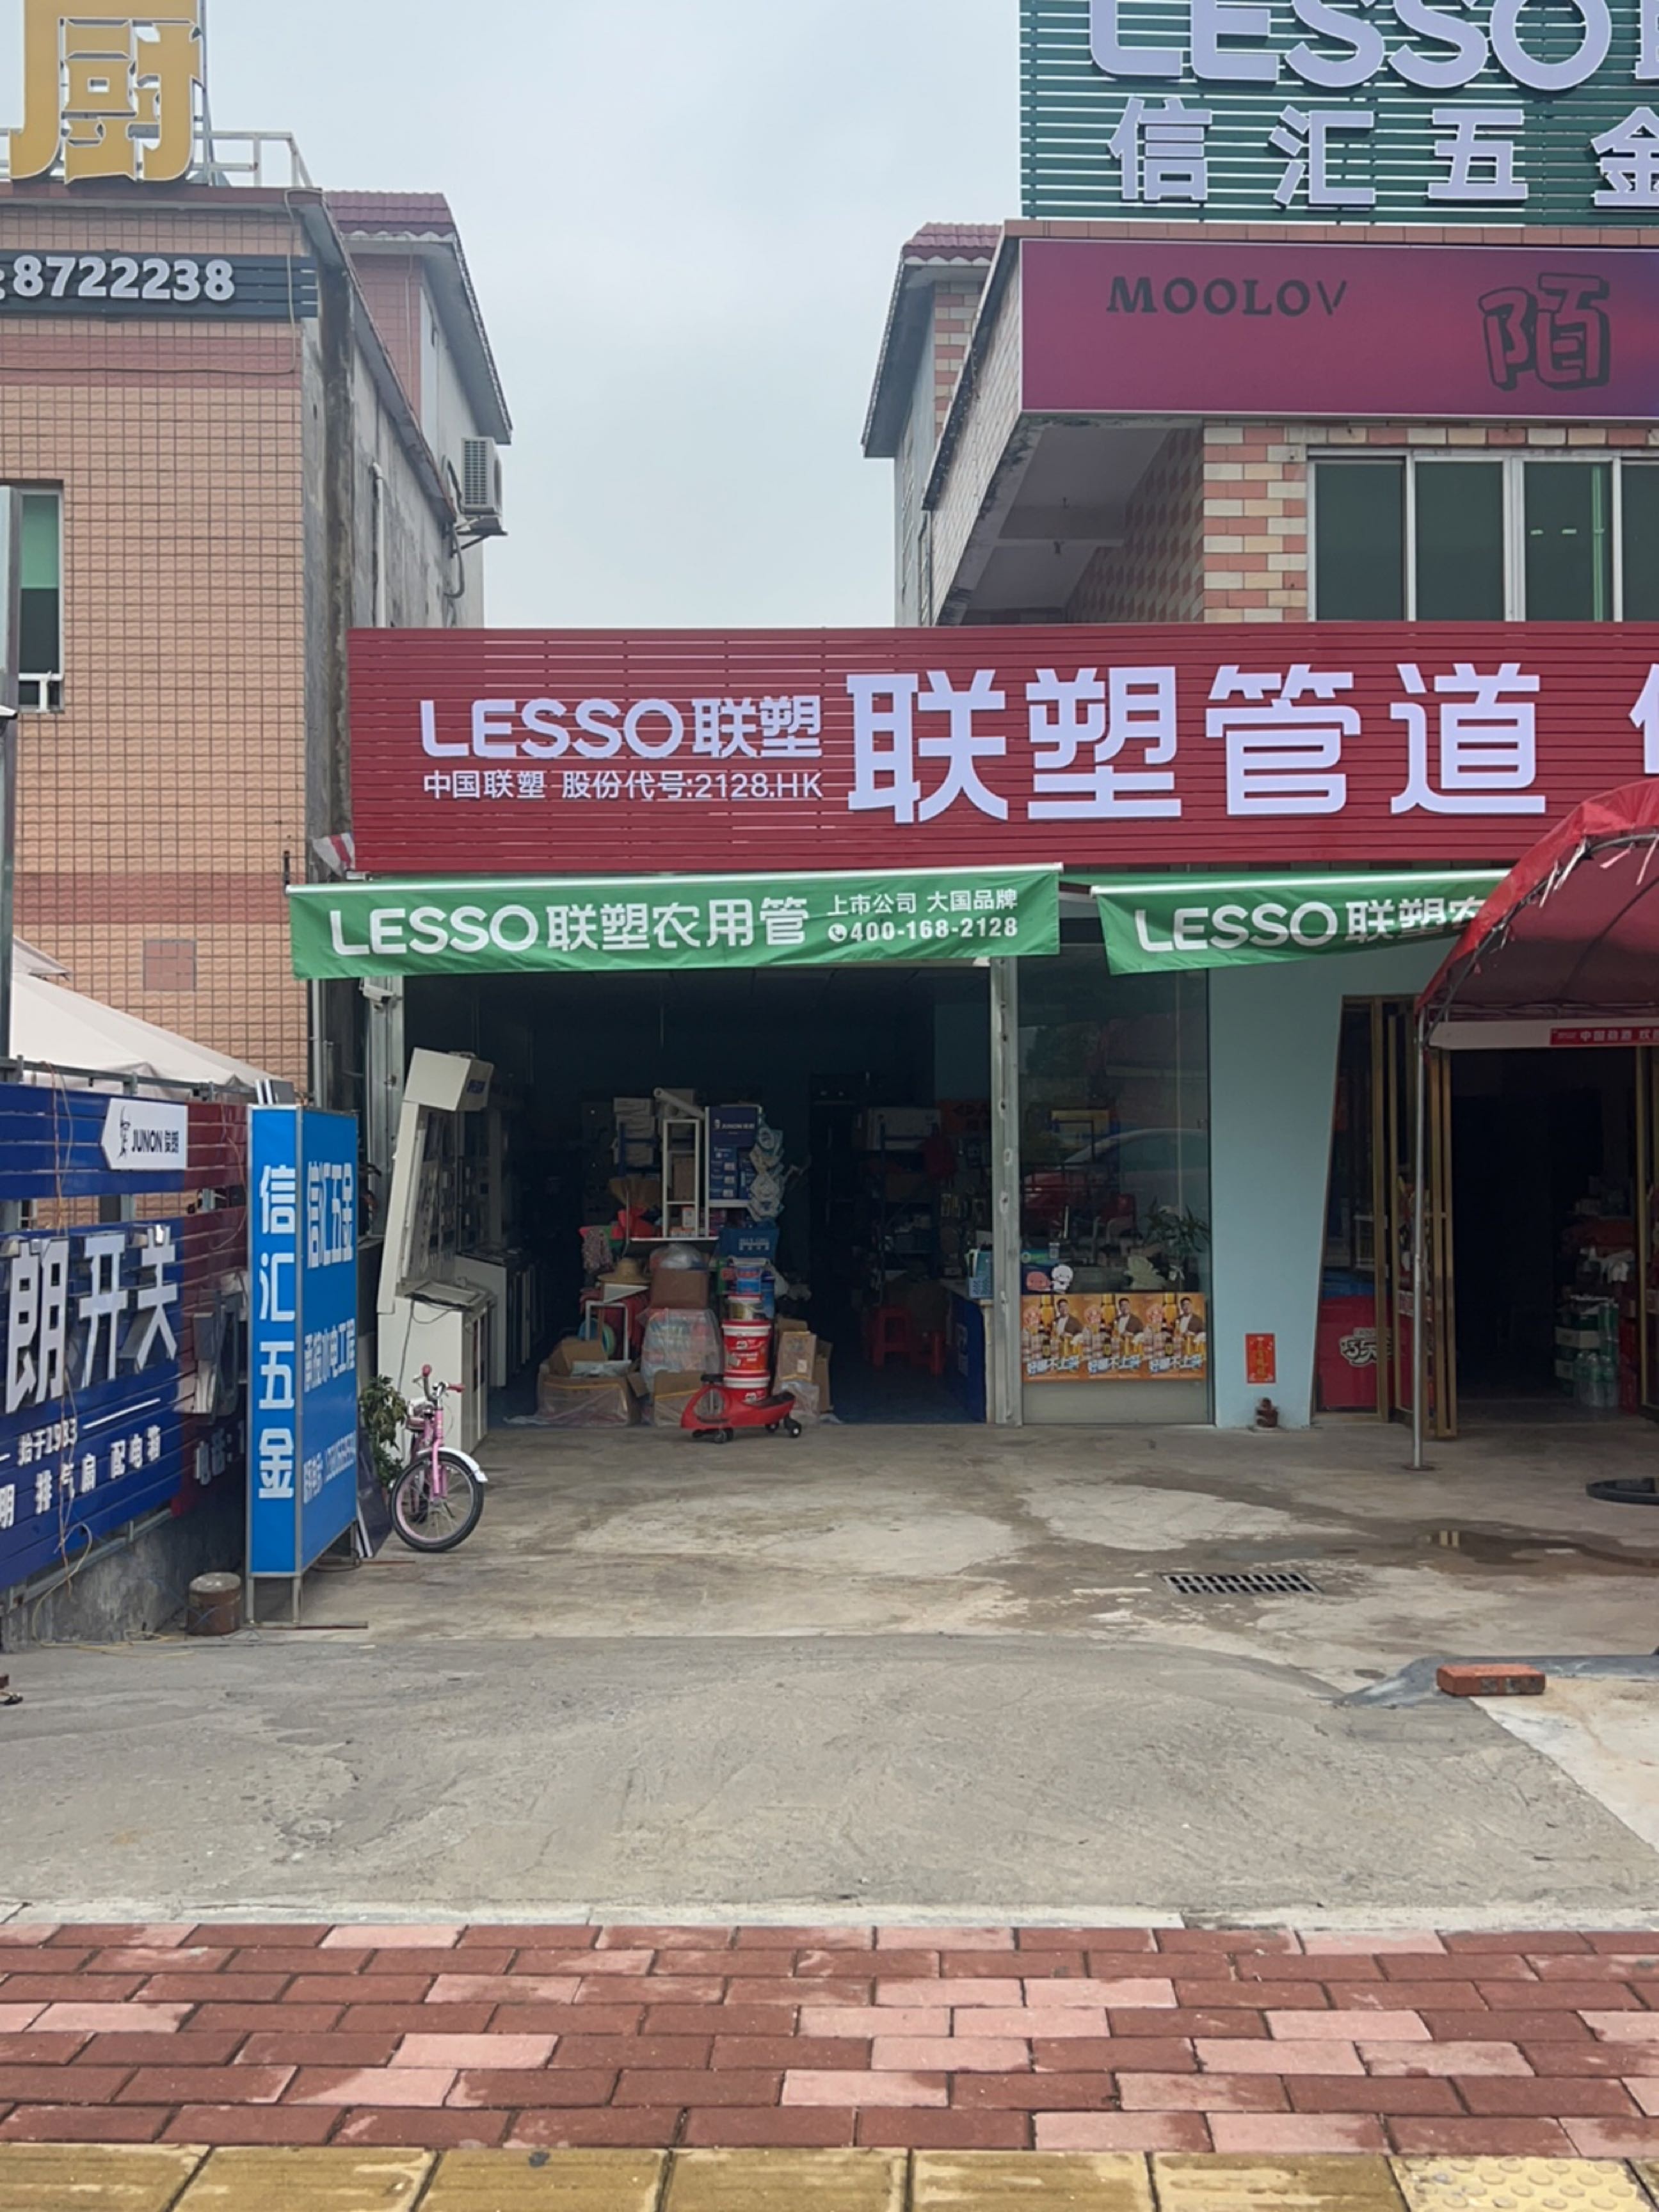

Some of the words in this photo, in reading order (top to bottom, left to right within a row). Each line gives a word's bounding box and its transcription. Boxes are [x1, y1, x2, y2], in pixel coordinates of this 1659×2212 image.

[10, 0, 201, 184] 厨
[1090, 0, 1659, 91] LESSO
[1109, 97, 1659, 207] 信汇五金
[423, 770, 545, 799] 中国联塑
[846, 662, 1546, 824] 联塑管道
[827, 892, 917, 917] 上市公司
[926, 888, 1018, 912] 大国品牌
[851, 917, 1019, 942] 400-168-2128
[307, 1161, 353, 1269] 信汇五金
[259, 1164, 296, 1499] 信汇五金
